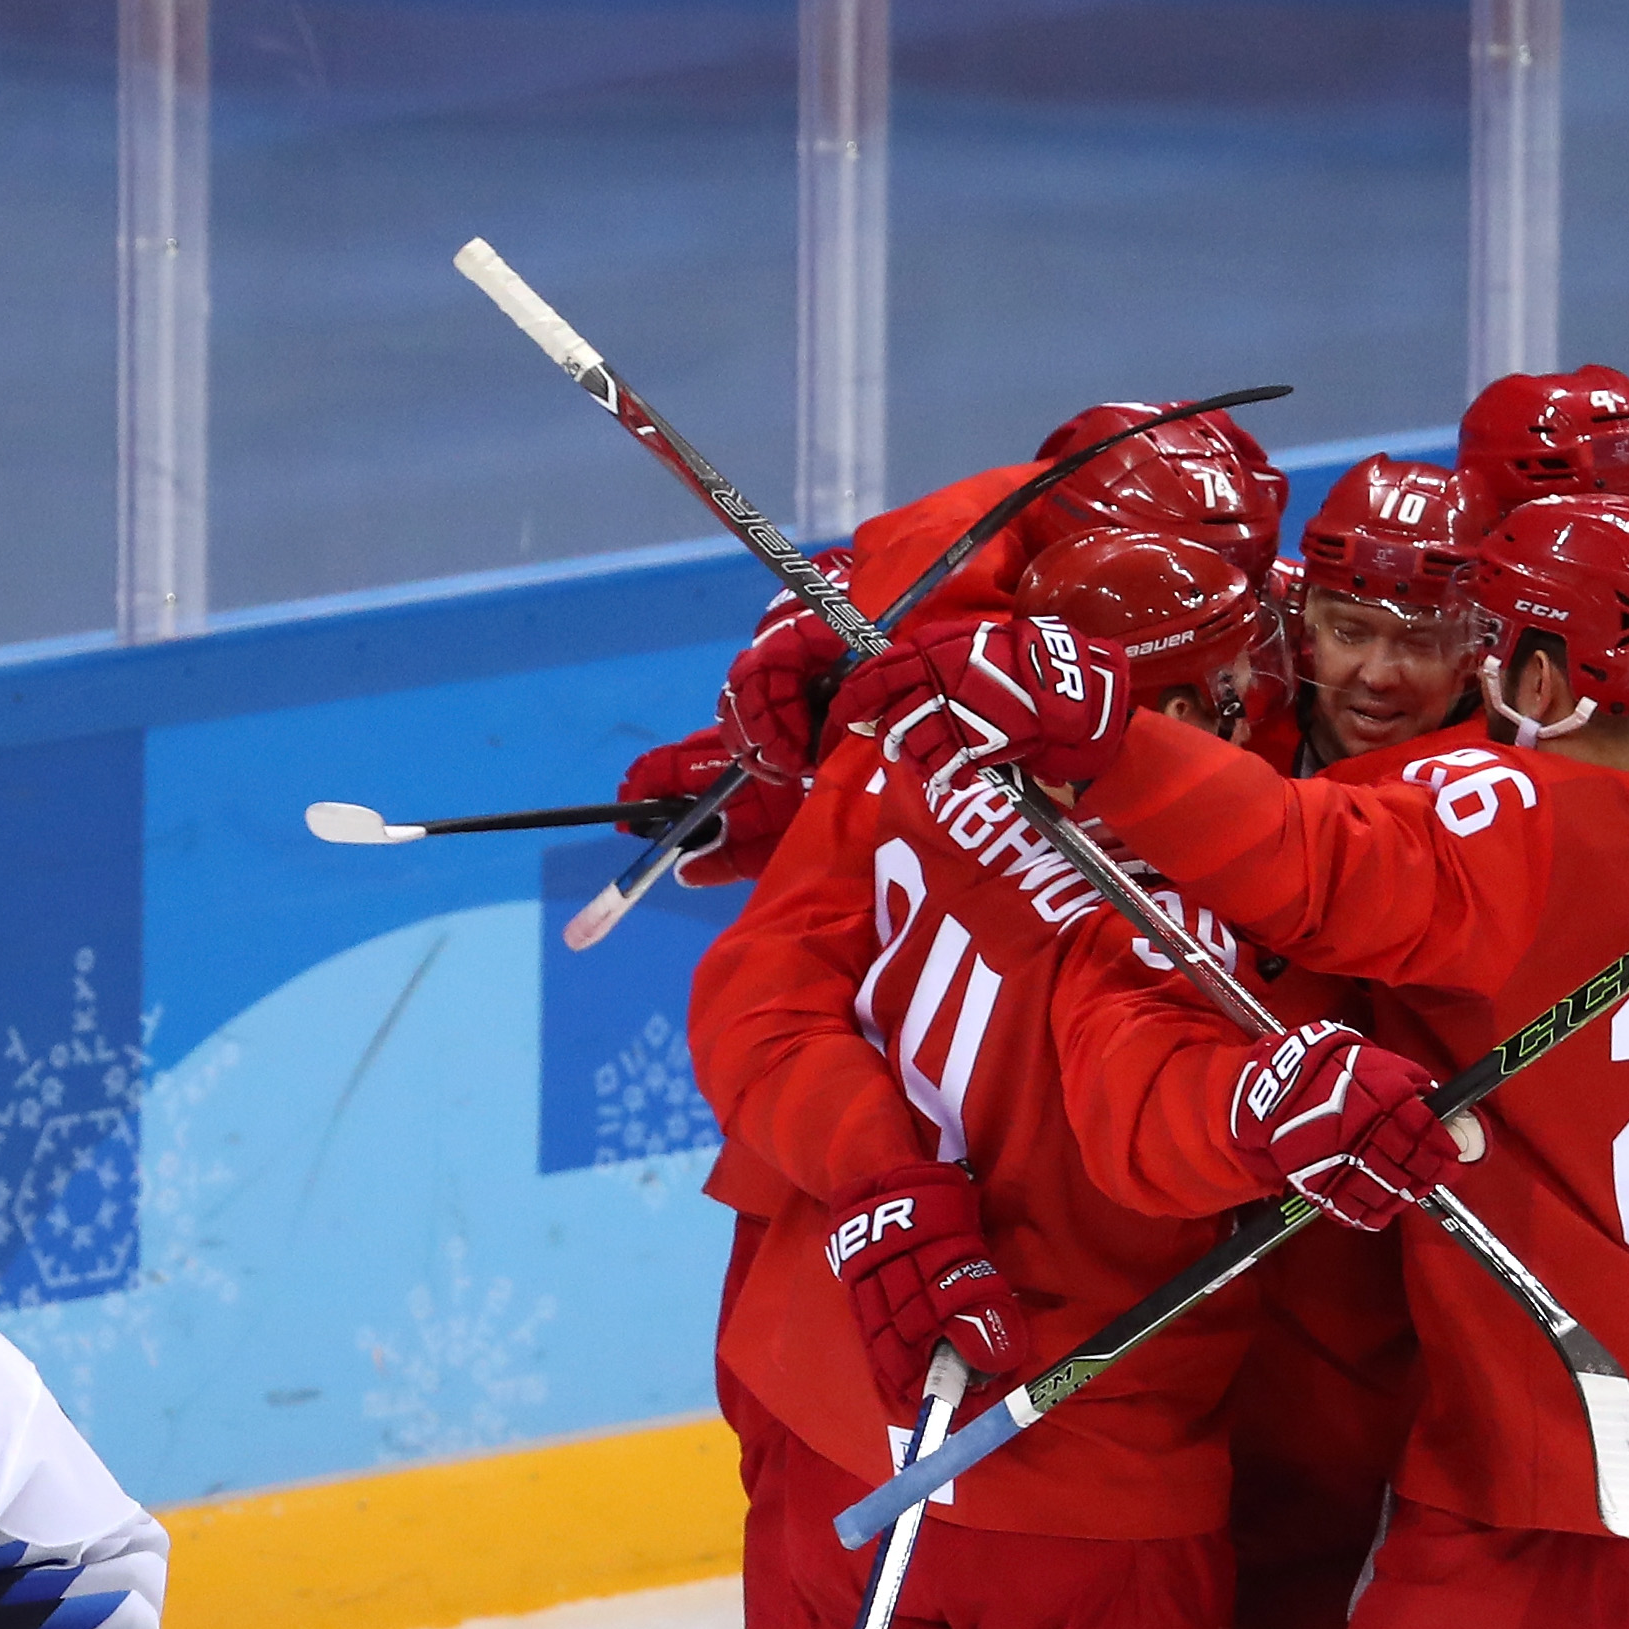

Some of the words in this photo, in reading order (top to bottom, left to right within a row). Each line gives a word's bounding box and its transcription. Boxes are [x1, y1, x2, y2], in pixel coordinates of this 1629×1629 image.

[1379, 487, 1427, 525] 10
[1514, 599, 1569, 622] CCM
[826, 614, 867, 653] VOYNOV
[1125, 629, 1195, 658] BAUER
